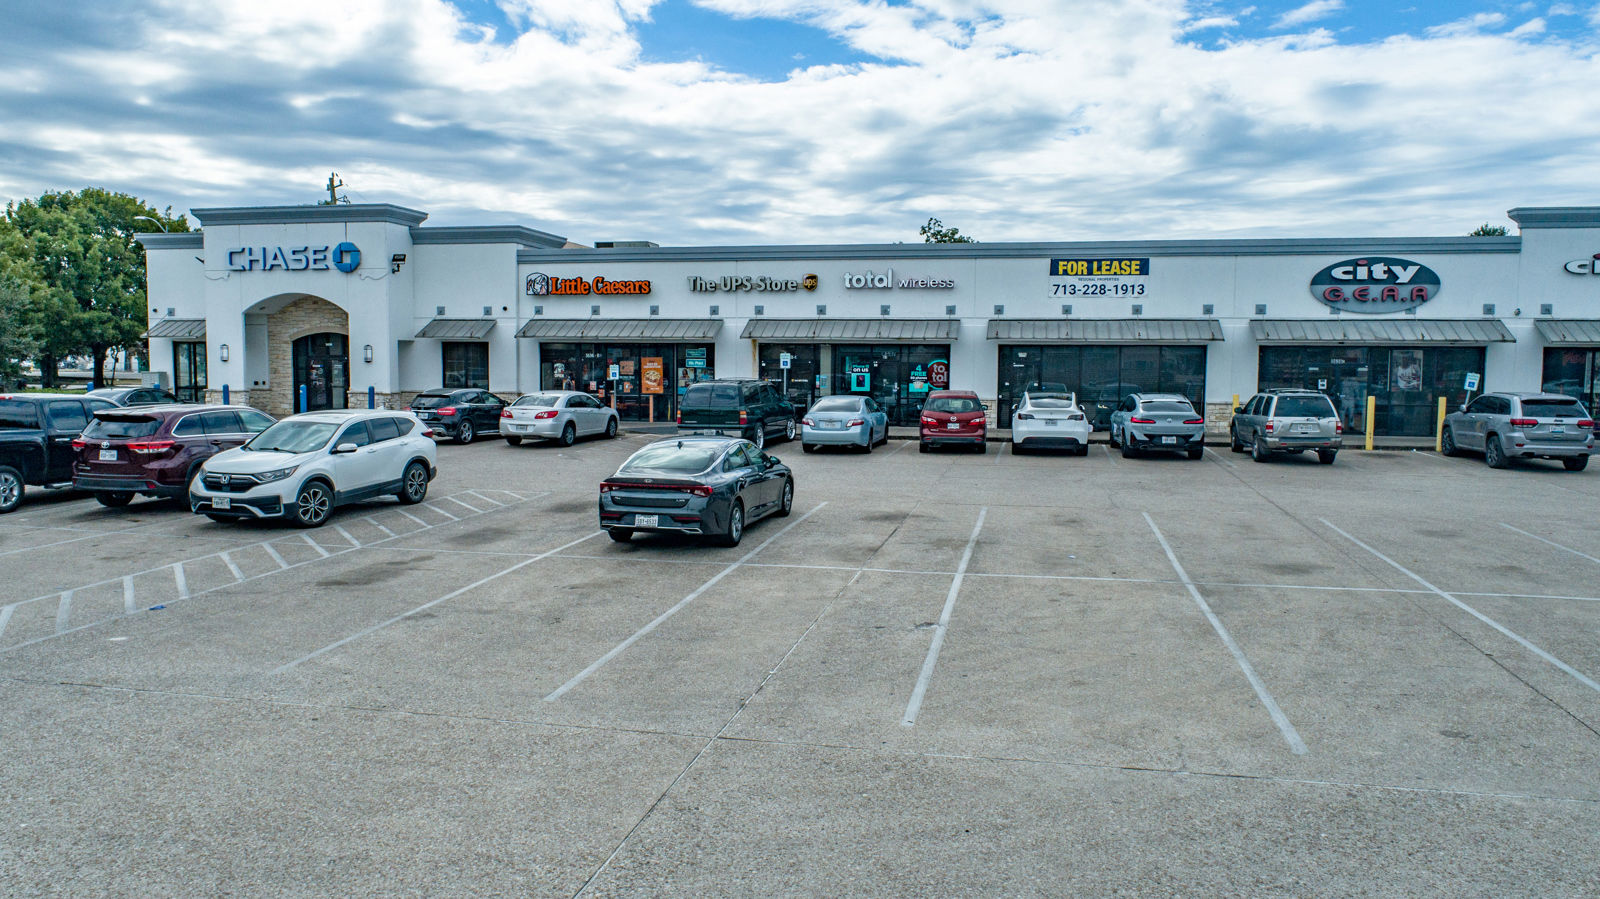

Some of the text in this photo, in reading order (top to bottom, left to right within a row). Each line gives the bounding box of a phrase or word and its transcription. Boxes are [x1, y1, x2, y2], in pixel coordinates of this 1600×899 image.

[227, 245, 330, 271] CHASE
[1058, 260, 1141, 275] FOR LEASE
[1331, 259, 1420, 284] city
[549, 276, 651, 295] Little Caesars
[687, 276, 798, 292] The UPS Store
[843, 268, 955, 289] total wireless
[1052, 283, 1145, 296] 713-228-1913
[915, 364, 922, 372] 4
[932, 364, 945, 373] to
[932, 371, 947, 382] tal
